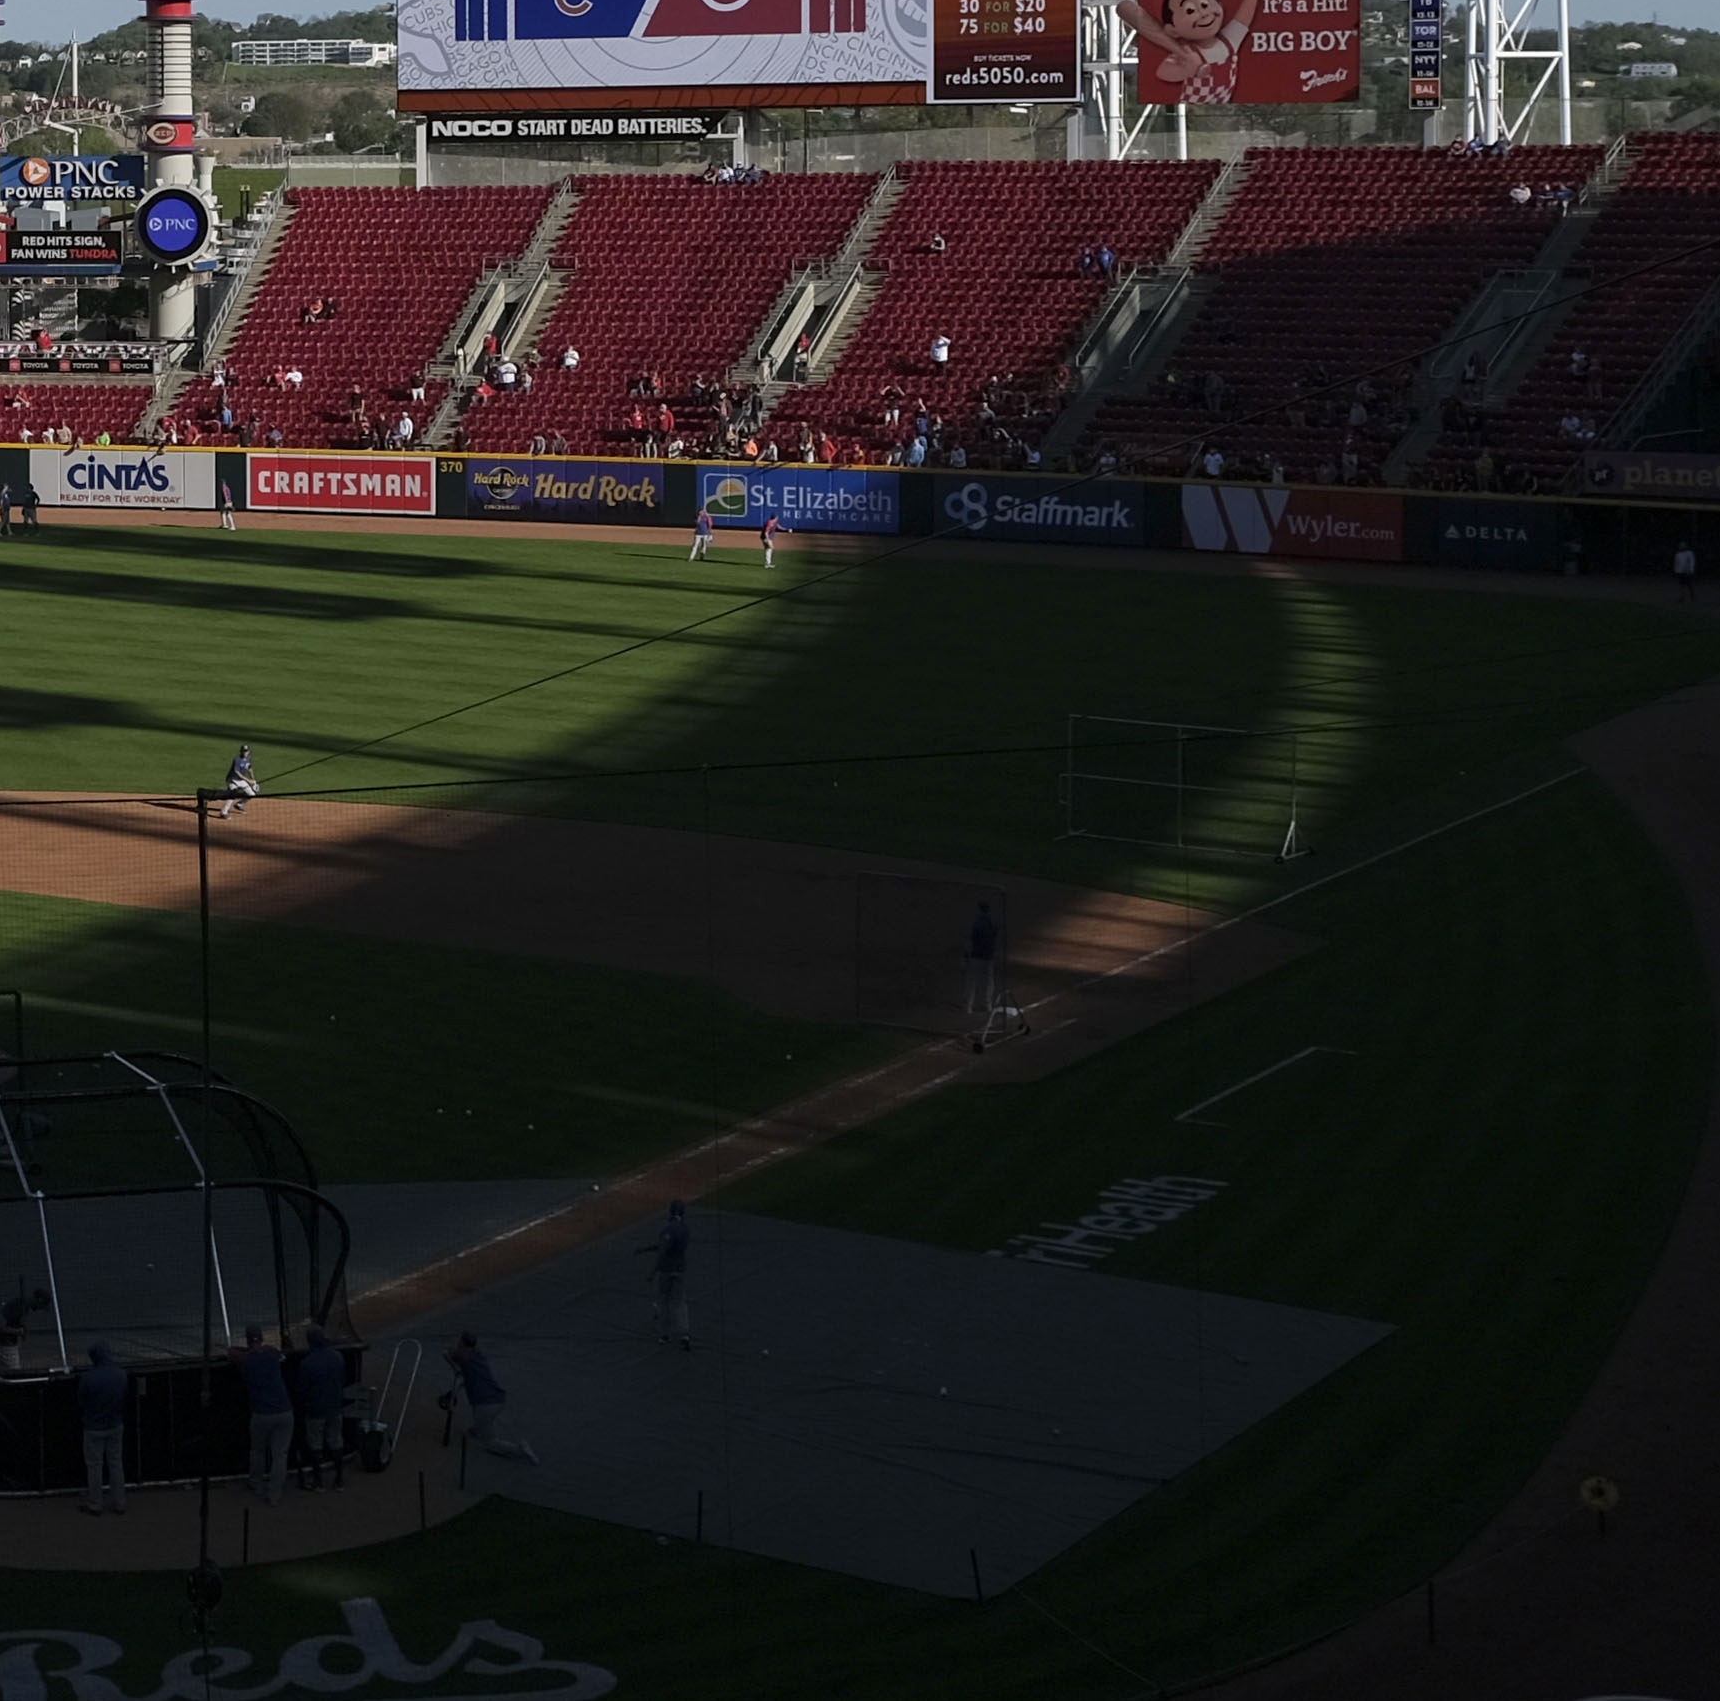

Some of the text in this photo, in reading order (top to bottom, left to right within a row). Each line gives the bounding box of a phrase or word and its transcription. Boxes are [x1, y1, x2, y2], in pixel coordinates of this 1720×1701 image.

[985, 1, 1010, 13] FOR
[1296, 0, 1308, 12] a
[959, 17, 1046, 35] 75 FOR $40
[1415, 26, 1437, 35] TOR
[1251, 31, 1352, 52] BIG BOY
[1414, 55, 1437, 64] NYY
[945, 67, 1063, 85] reds5050.com
[1415, 84, 1436, 94] BAL
[432, 118, 707, 137] NOCO START DEAD BATTERIES.
[53, 160, 119, 185] PNC
[5, 185, 136, 199] POWER STACKS
[165, 218, 196, 231] PNC
[22, 236, 107, 248] RED HITS SIGN,
[11, 249, 118, 259] FAN WINS TUNDRA
[439, 461, 463, 474] 370
[258, 471, 421, 497] CRAFTSMAN
[474, 473, 530, 488] Hard Rock
[534, 474, 656, 508] Hard Rock
[783, 486, 892, 512] Elizabeth
[783, 509, 893, 524] HEALTHCARE
[994, 495, 1130, 528] Staffmark
[1286, 513, 1395, 542] Wyler.com
[1464, 524, 1528, 542] DELTA
